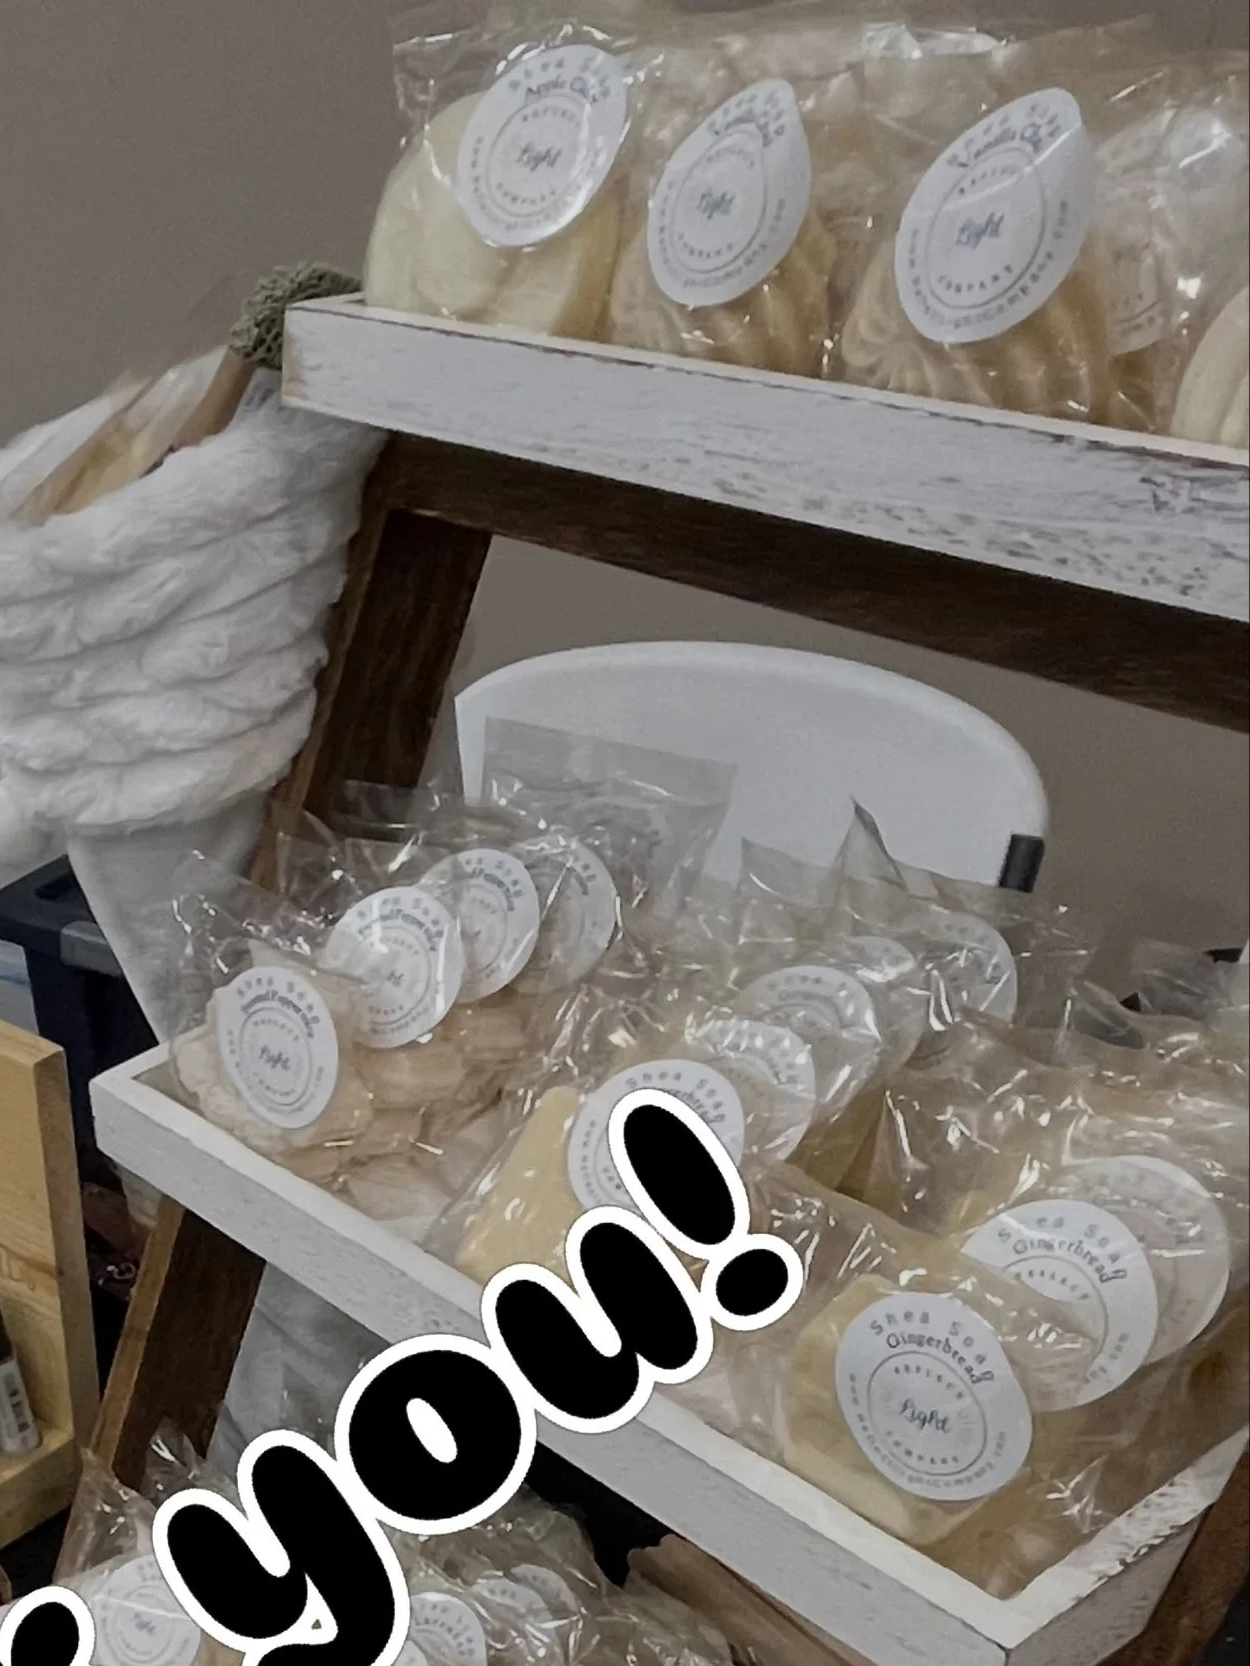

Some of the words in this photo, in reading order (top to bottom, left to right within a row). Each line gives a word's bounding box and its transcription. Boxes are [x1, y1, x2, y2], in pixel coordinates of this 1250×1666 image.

[1012, 1239, 1120, 1284] Gingerbread
[869, 1310, 930, 1336] Shea
[885, 1331, 990, 1385] Gingerbread
[899, 1397, 952, 1434] Light
